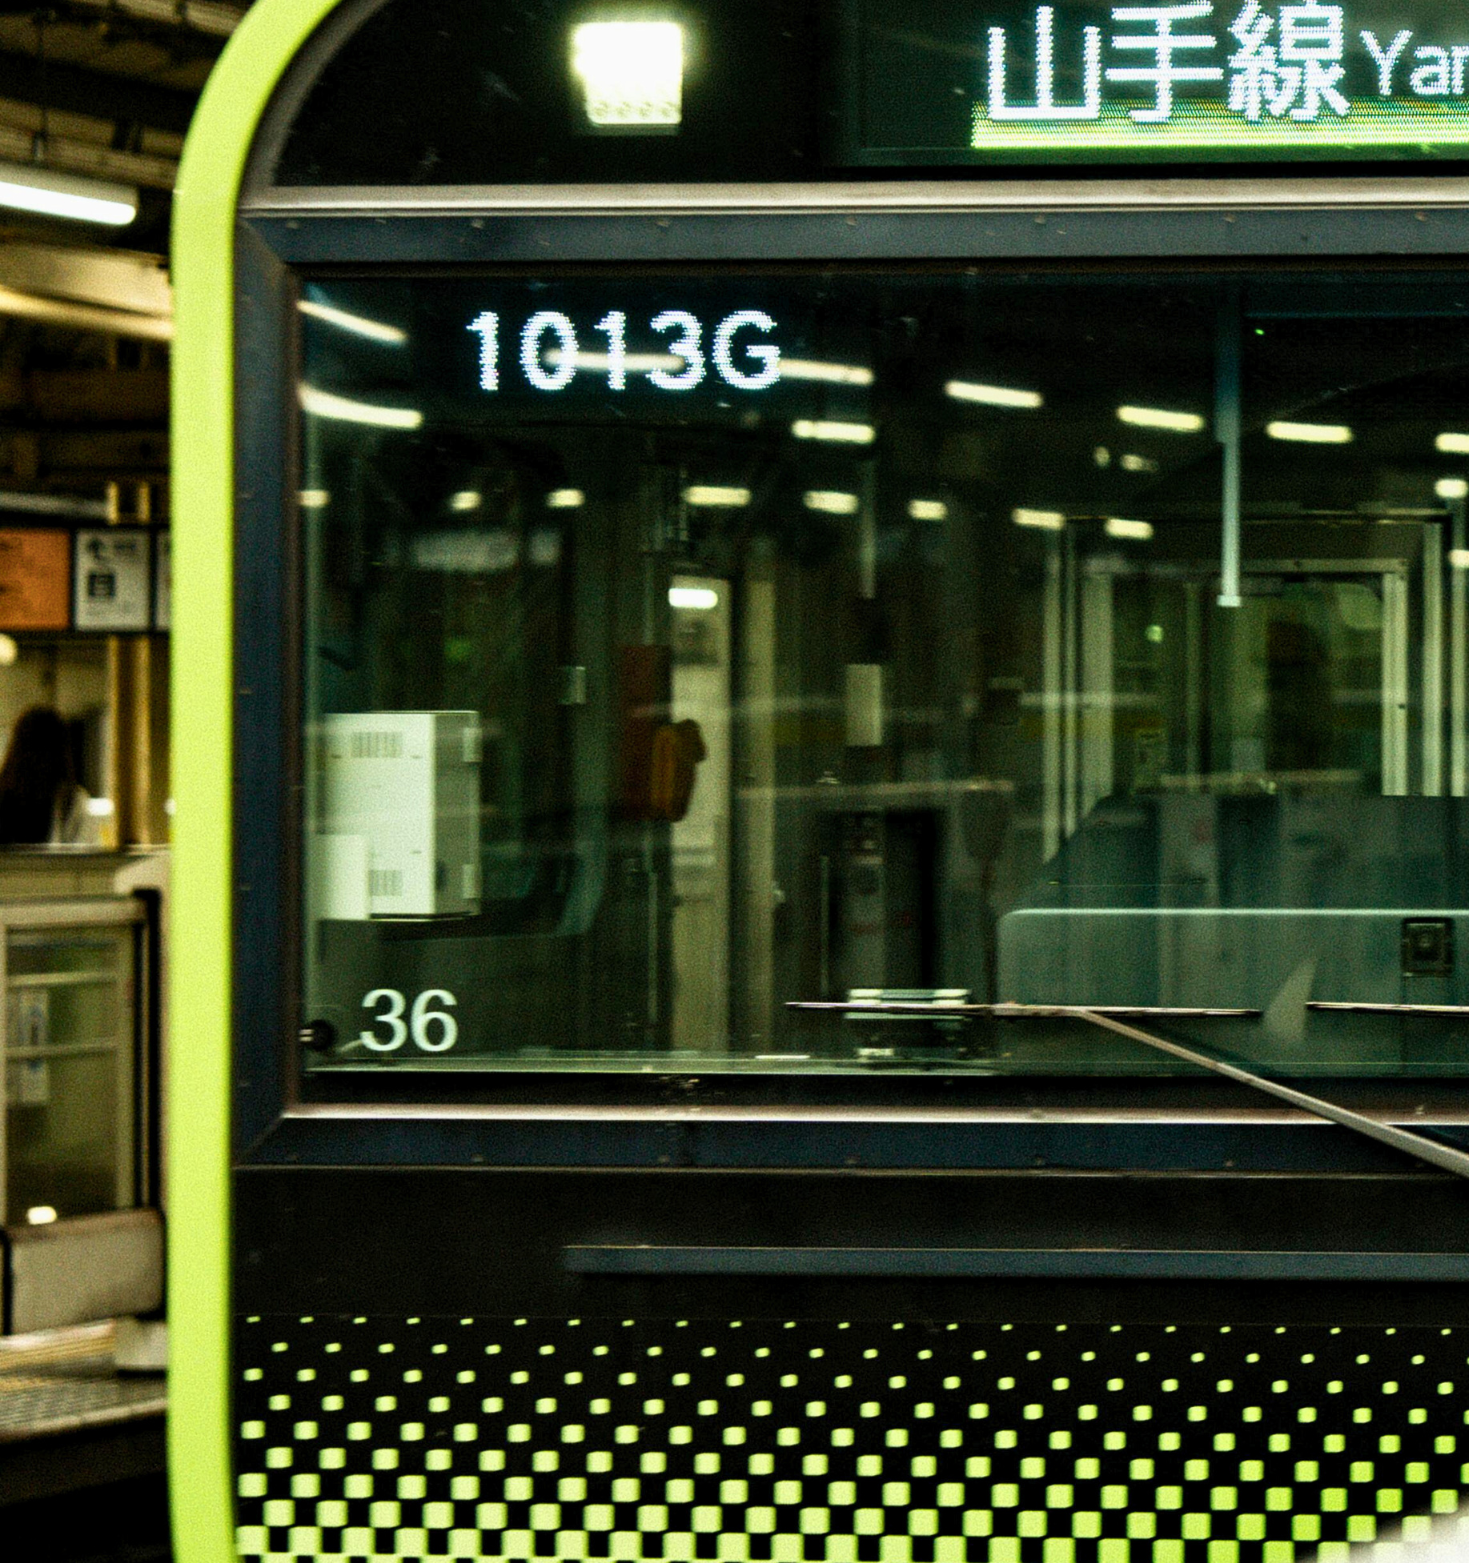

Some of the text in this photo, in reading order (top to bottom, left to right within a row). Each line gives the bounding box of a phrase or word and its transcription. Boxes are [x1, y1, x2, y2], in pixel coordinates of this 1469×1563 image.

[986, 0, 1351, 124] 山手線
[466, 310, 781, 391] 1013G
[360, 988, 459, 1052] 36
